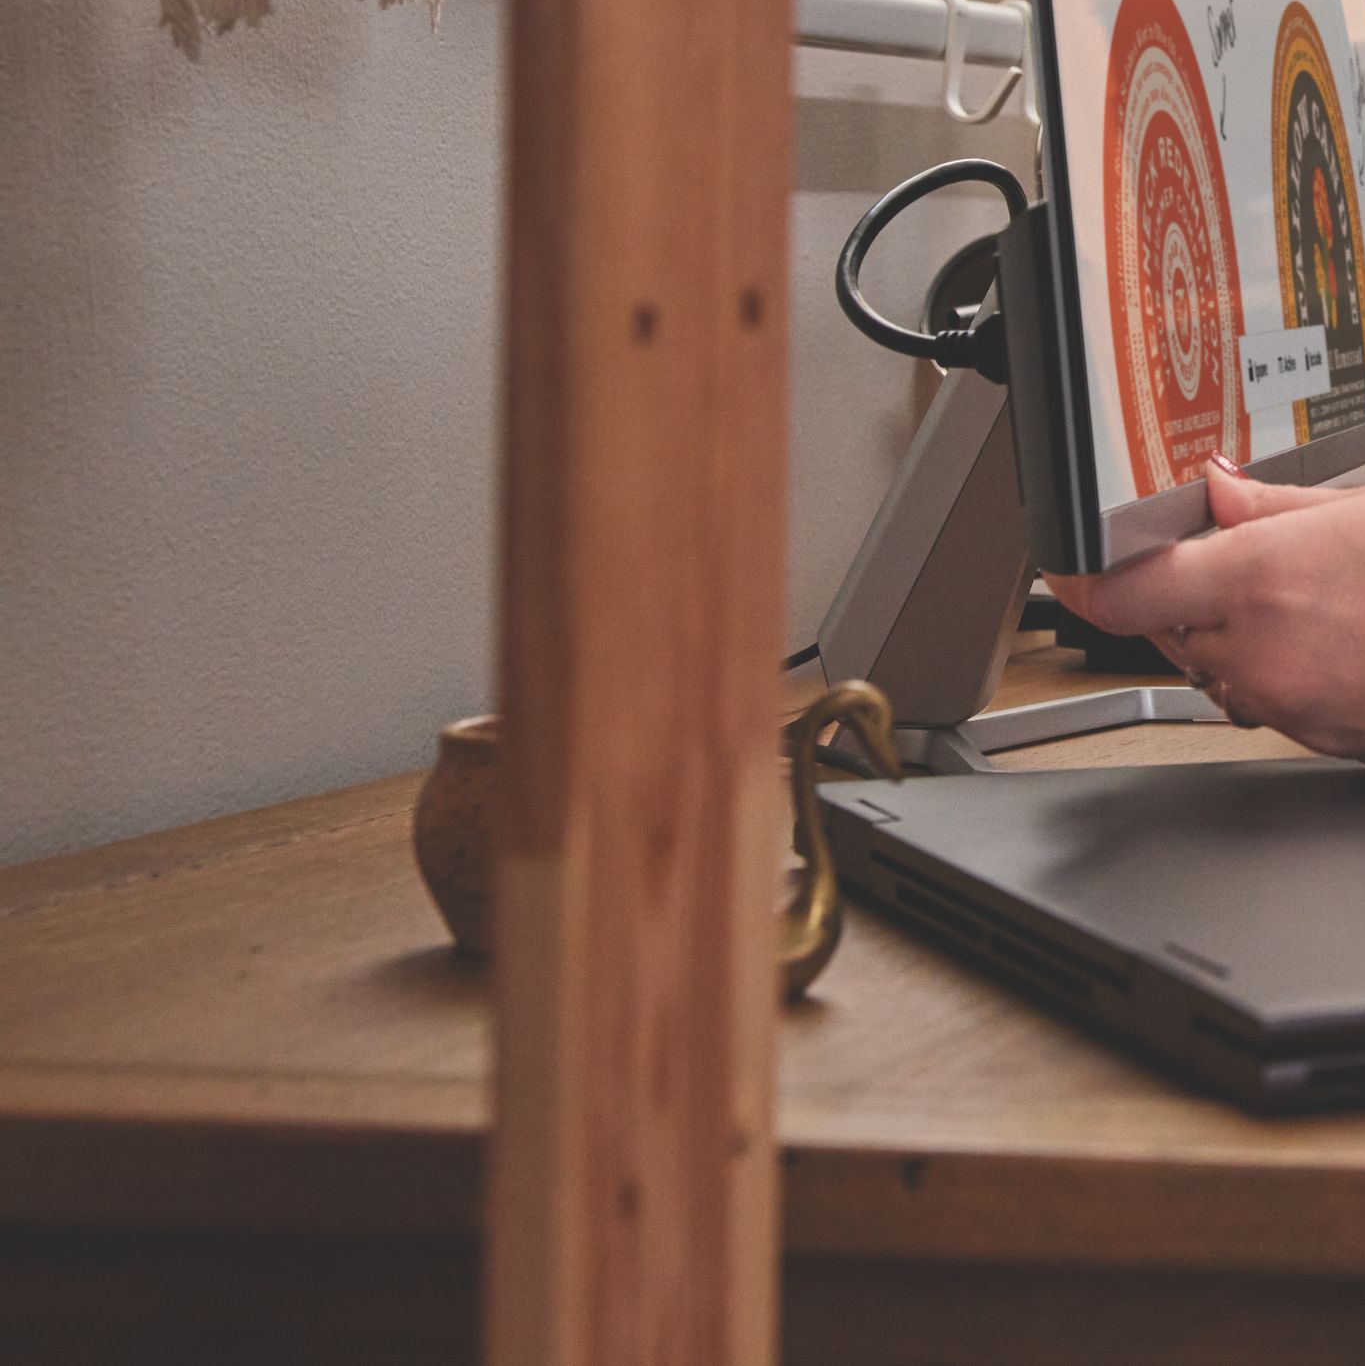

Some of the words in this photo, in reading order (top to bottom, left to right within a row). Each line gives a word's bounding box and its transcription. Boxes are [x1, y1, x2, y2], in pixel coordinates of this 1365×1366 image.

[1142, 149, 1166, 400] REDNECK
[1157, 136, 1219, 387] REDEMPTION
[1291, 93, 1310, 327] TALLOW
[1312, 101, 1360, 325] CANDLE
